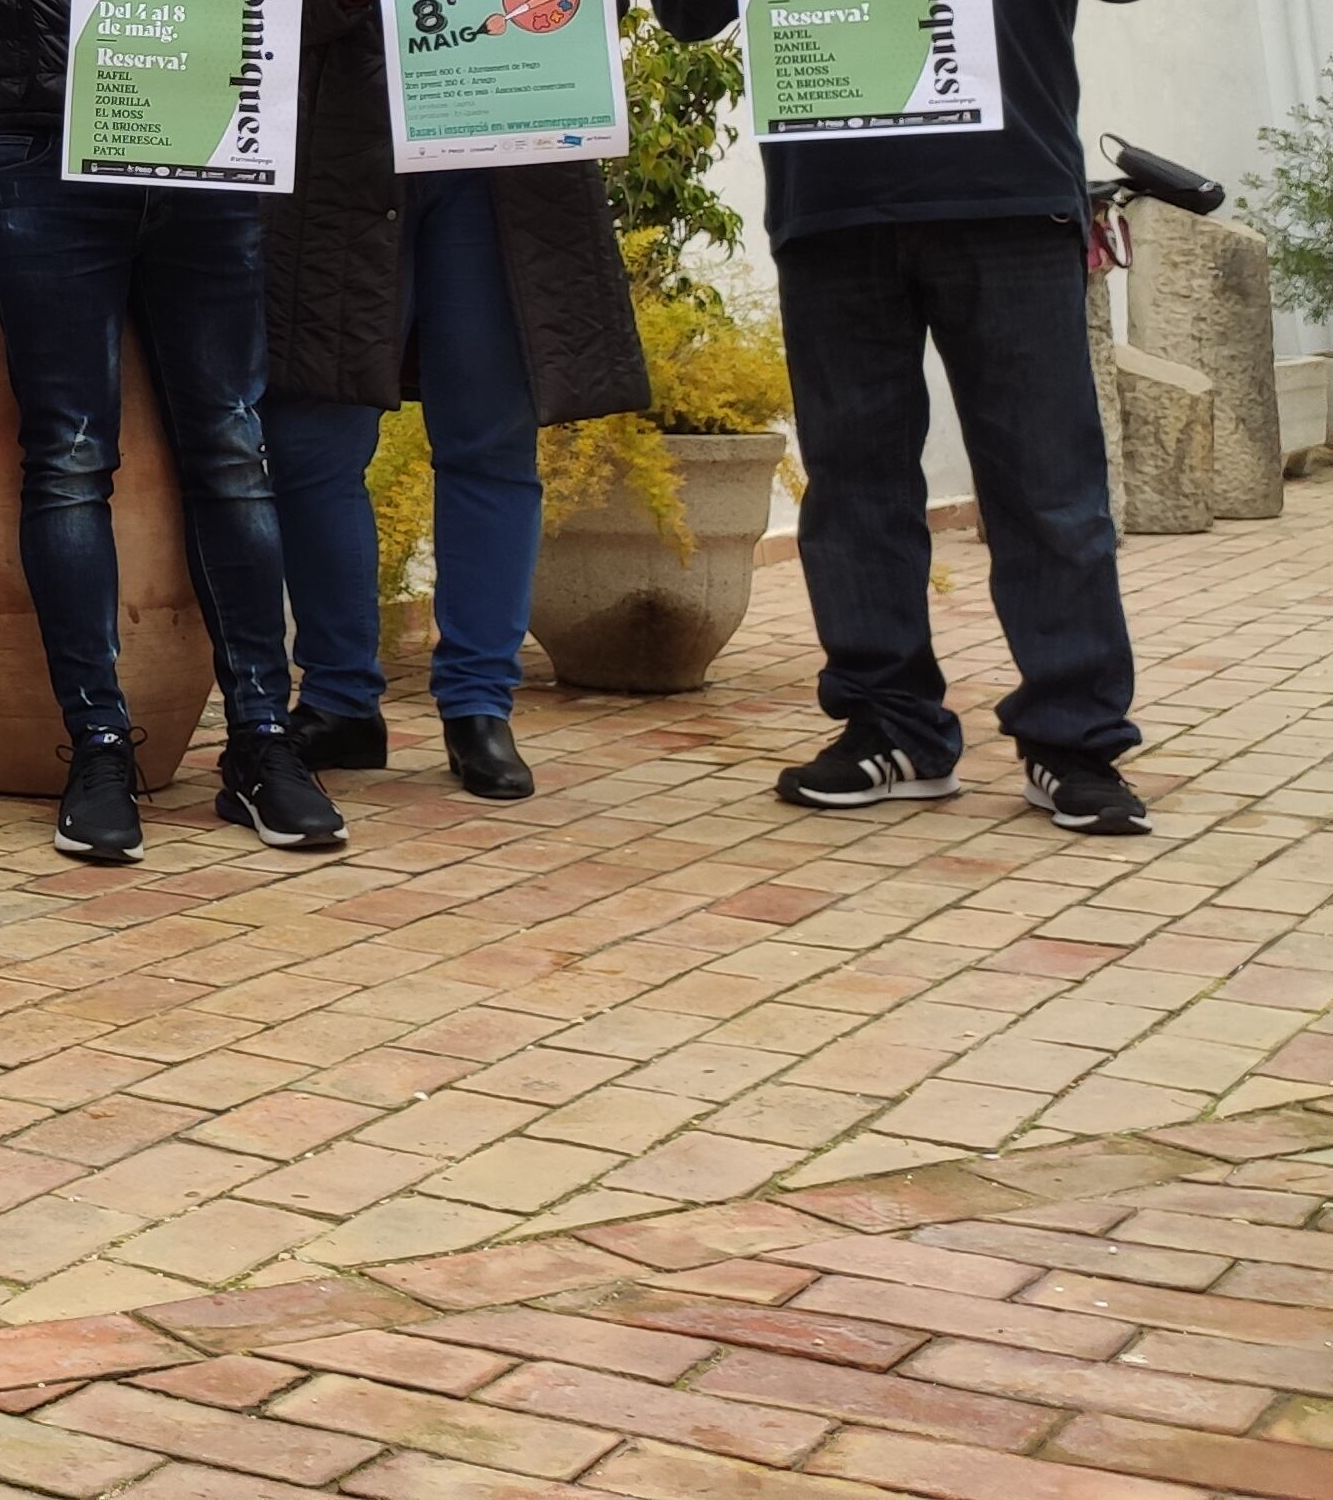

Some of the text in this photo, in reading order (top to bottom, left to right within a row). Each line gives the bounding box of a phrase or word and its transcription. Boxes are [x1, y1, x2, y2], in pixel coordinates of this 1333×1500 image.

[98, 1, 185, 22] Del 4 al 8
[412, 0, 448, 34] 8
[769, 2, 869, 27] Reserva!
[98, 18, 177, 42] de maig.
[773, 29, 811, 40] RAFEL
[408, 26, 477, 54] MAIG
[774, 41, 820, 53] DANIEL
[97, 47, 187, 70] Reserva!
[774, 52, 835, 65] ZORRILLA
[97, 70, 131, 80] RAFEL
[776, 65, 829, 77] EL MOSS
[96, 82, 137, 93] DANIEL
[776, 76, 849, 89] CA BRIONES
[95, 95, 150, 107] ZORRILLA
[777, 88, 863, 101] CA MERESCAL
[95, 108, 143, 119] EL MOSS
[778, 103, 813, 114] PATXI
[94, 120, 160, 133] CA BRIONES
[93, 133, 171, 146] CA MERESCAL
[93, 145, 125, 156] PATXI
